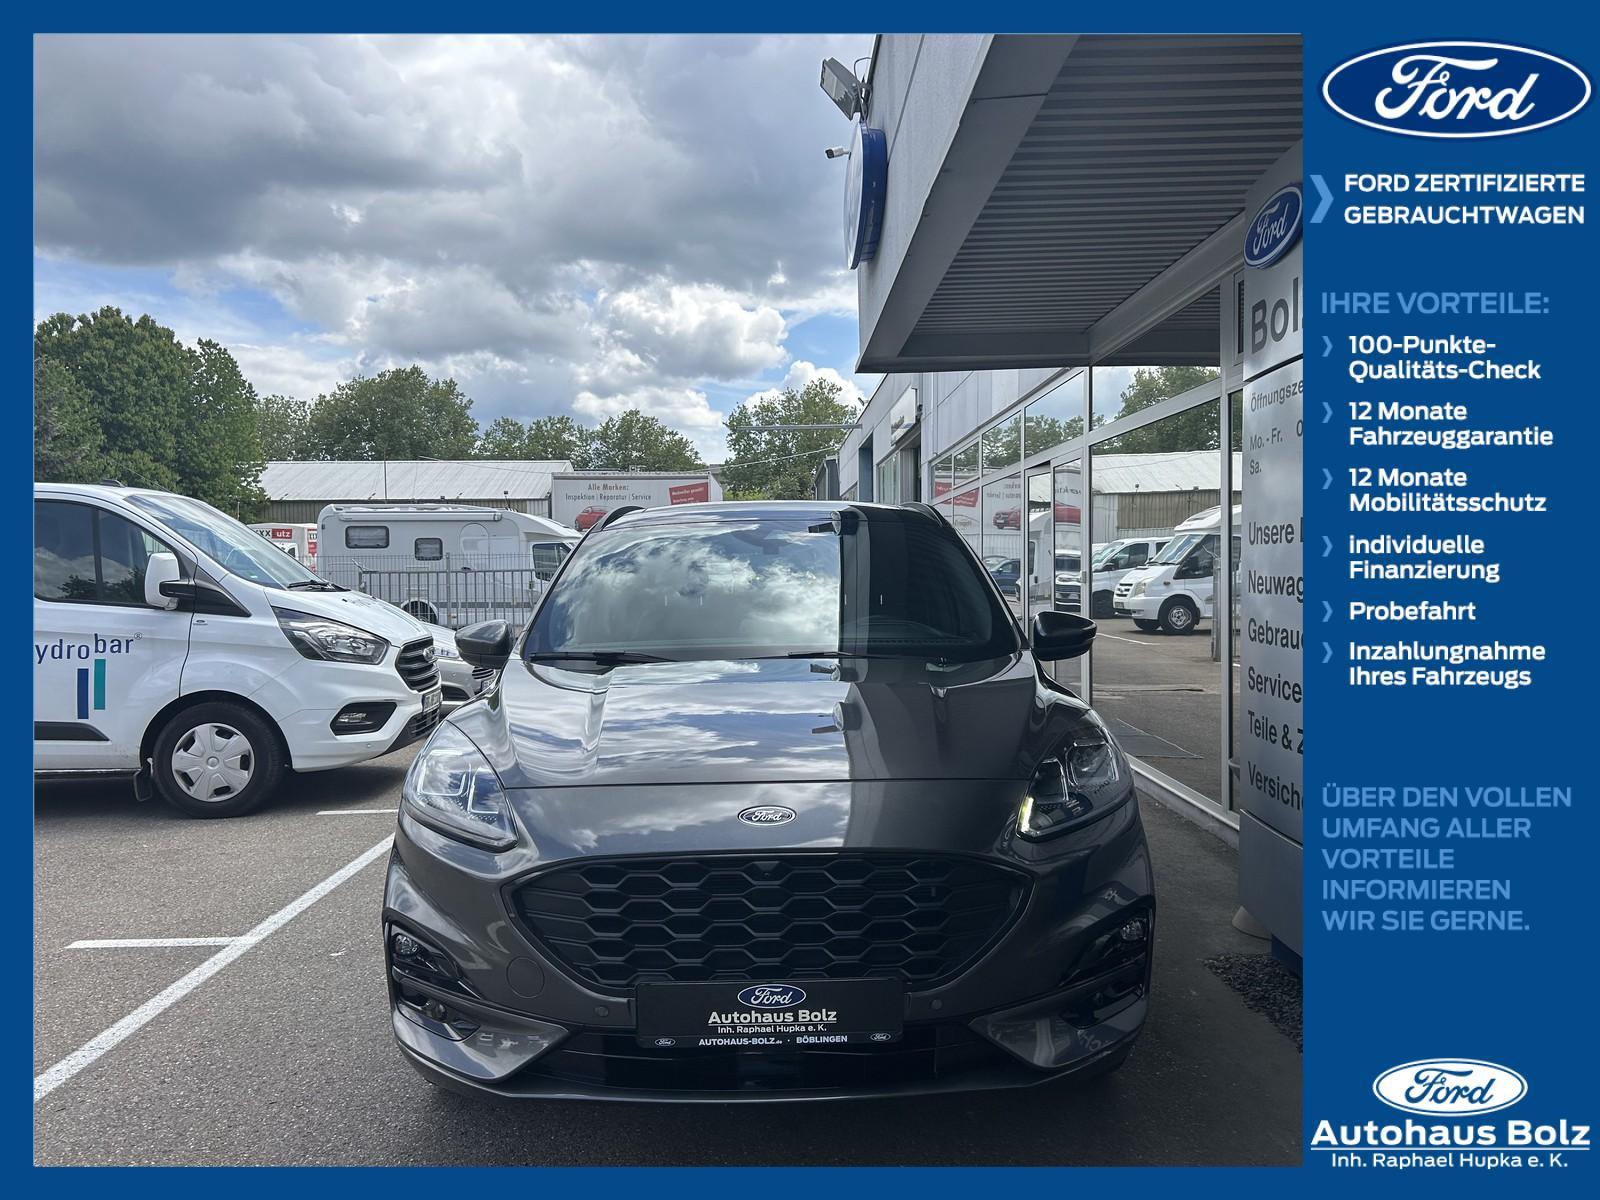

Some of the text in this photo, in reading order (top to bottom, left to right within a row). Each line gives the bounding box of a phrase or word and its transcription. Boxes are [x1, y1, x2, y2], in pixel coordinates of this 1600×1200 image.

[1252, 201, 1289, 256] Ford
[1252, 276, 1304, 354] Bol
[1271, 427, 1283, 444] Fr.
[1249, 459, 1262, 475] Sa.
[588, 483, 600, 491] Alle
[566, 492, 595, 502] Inspektion
[631, 493, 651, 501] Service
[1248, 521, 1295, 545] Unsere
[1247, 617, 1304, 650] Gebrau
[1247, 665, 1302, 703] Service
[1247, 709, 1278, 745] Teile
[1281, 723, 1292, 751] &
[1247, 760, 1304, 811] Versich
[750, 987, 793, 1005] Ford
[708, 1009, 837, 1024] Autohaus Bolz
[718, 1026, 735, 1034] Inh.
[736, 1025, 775, 1034] Raphael
[776, 1024, 806, 1033] Hupka
[817, 1023, 827, 1031] K.
[796, 1035, 848, 1044] BÖBLINGEN
